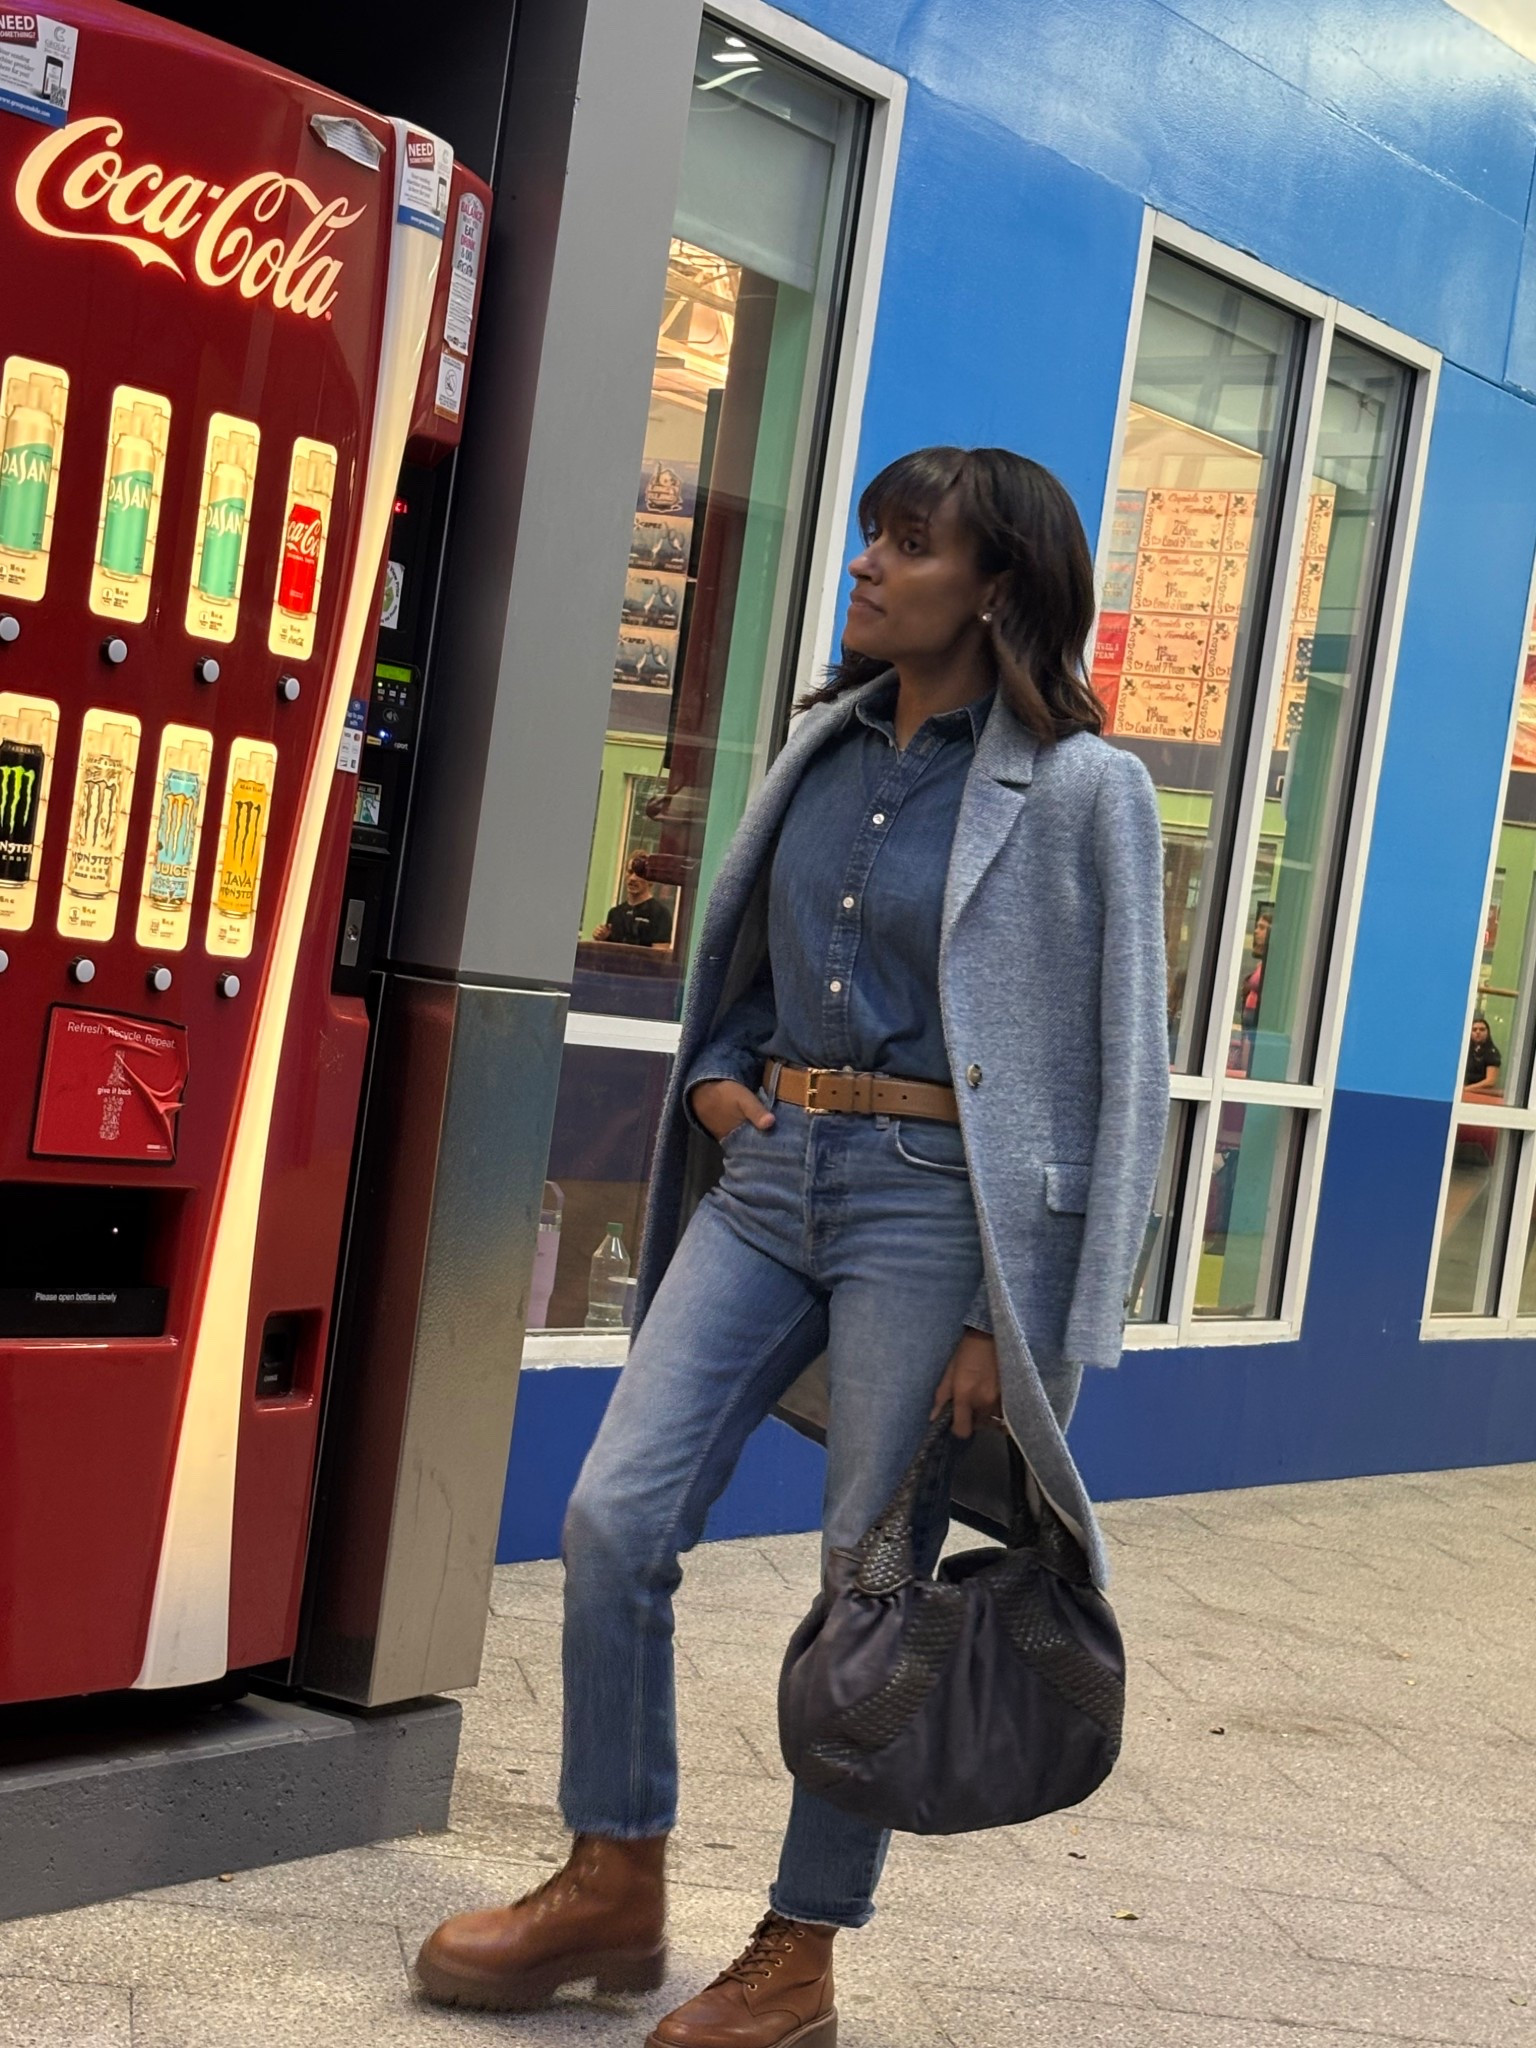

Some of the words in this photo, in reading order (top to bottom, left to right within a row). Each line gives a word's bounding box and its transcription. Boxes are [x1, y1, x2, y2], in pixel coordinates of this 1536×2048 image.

[408, 143, 434, 156] NEED
[15, 117, 367, 320] Coca-Cola
[156, 863, 189, 878] JUICE
[224, 869, 252, 888] JAVA
[97, 1087, 110, 1095] give
[35, 1292, 57, 1301] Please
[58, 1294, 75, 1303] open
[75, 1292, 97, 1301] bottles
[97, 1292, 118, 1303] slowly
